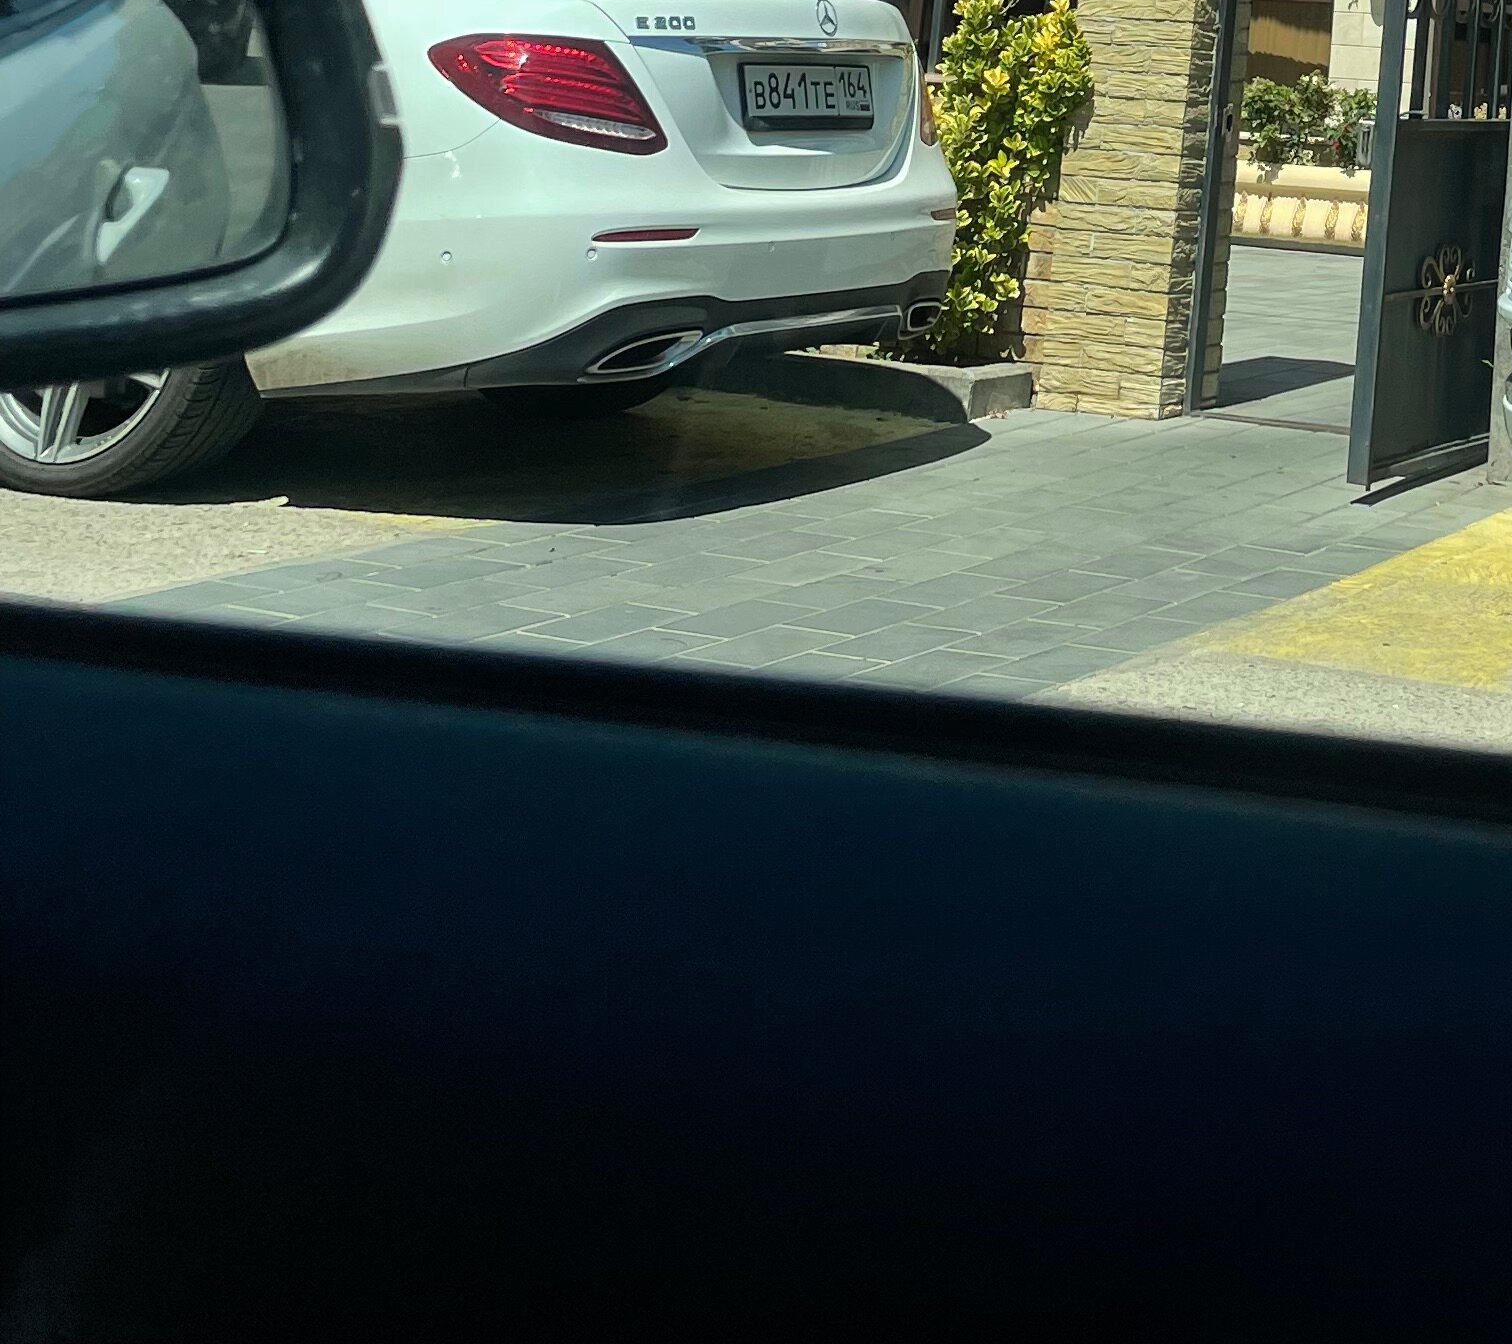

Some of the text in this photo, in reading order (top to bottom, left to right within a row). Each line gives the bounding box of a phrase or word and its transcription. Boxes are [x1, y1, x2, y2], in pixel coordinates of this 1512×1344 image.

[636, 15, 697, 31] E 200
[753, 71, 867, 110] В841ТЕ 164
